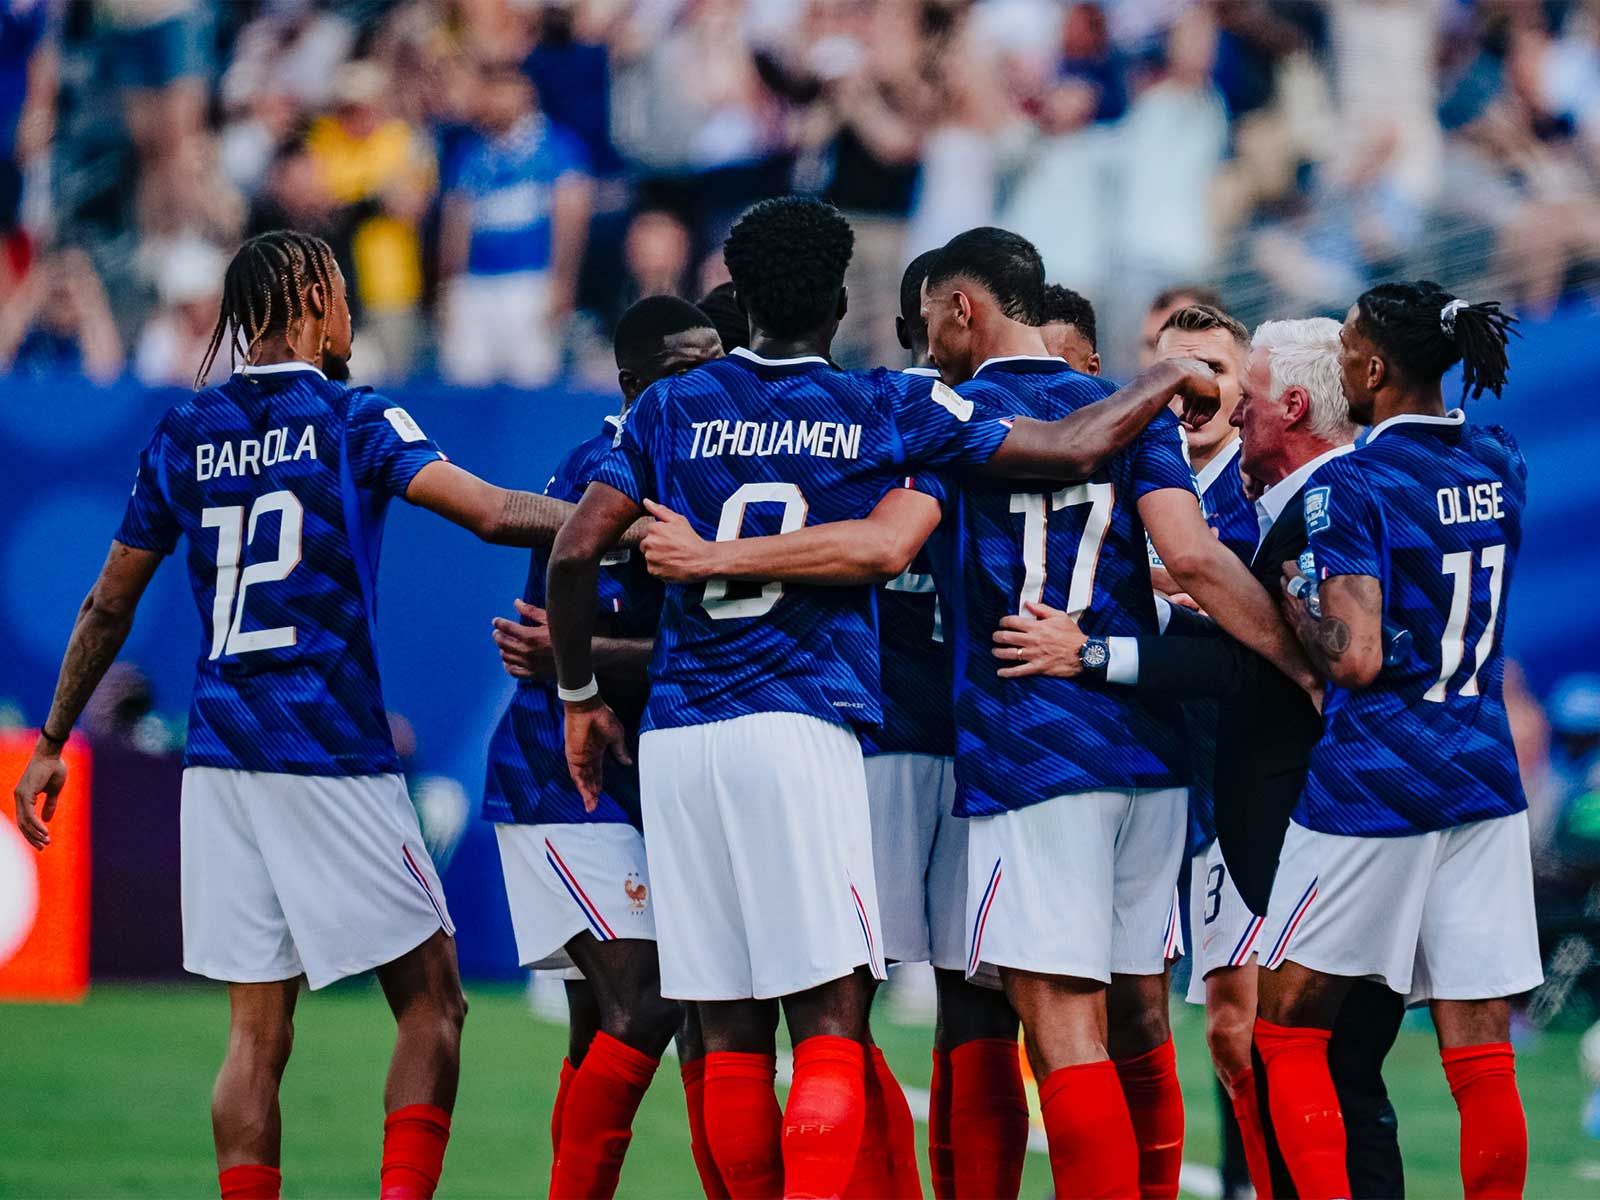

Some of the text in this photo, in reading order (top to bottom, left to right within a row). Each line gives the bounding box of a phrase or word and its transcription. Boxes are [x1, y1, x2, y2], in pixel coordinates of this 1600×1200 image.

[690, 419, 862, 459] TCHOUAMENI
[1437, 481, 1505, 525] OLISE
[201, 490, 304, 661] 12
[1009, 482, 1116, 624] 17
[1423, 544, 1506, 703] 11
[1203, 863, 1226, 926] 3
[786, 1124, 834, 1137] FFF
